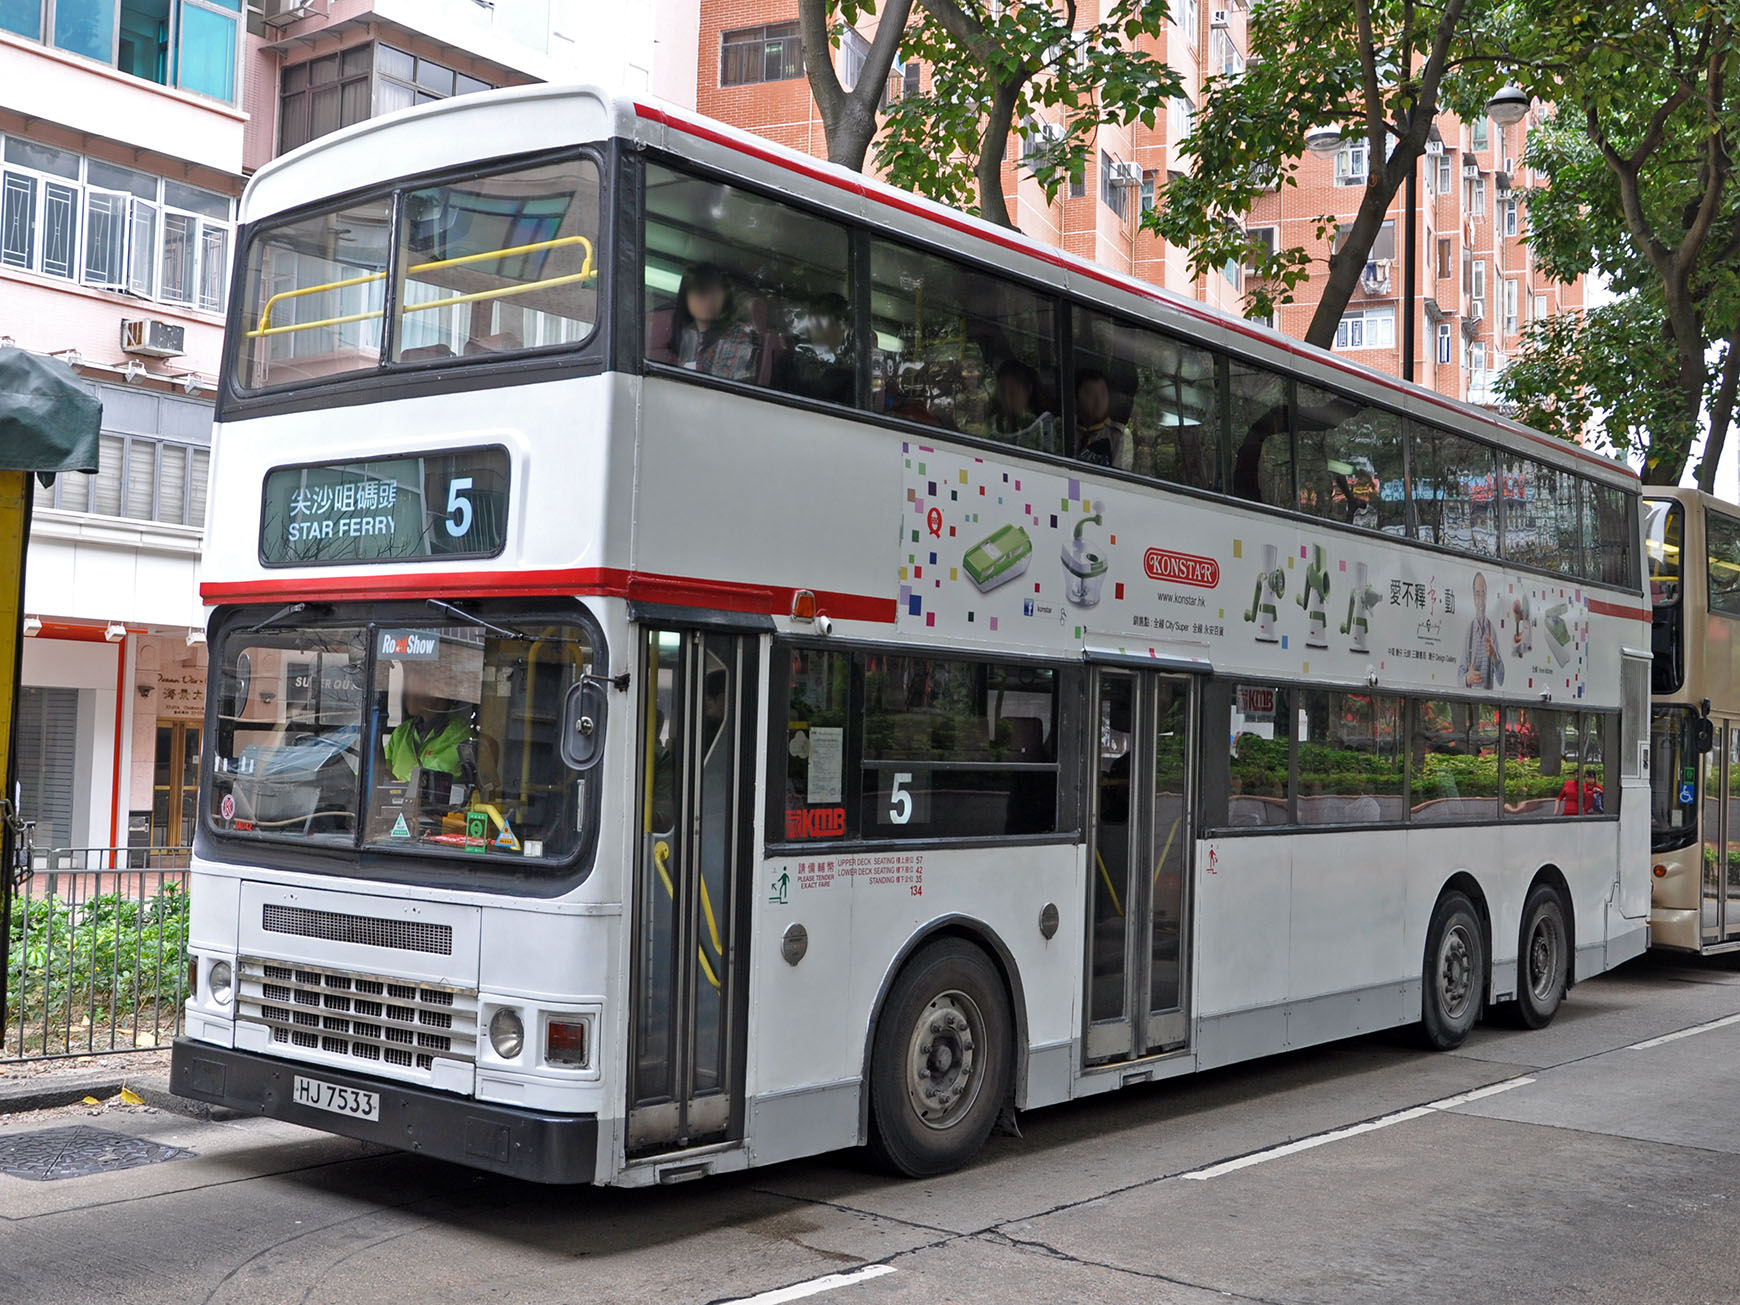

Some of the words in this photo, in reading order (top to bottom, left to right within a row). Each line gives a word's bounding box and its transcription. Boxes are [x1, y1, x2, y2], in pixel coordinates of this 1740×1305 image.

[289, 480, 398, 517] 尖沙咀碼頭
[445, 477, 473, 538] 5
[288, 520, 333, 541] STAR
[338, 515, 395, 537] FERRY
[1148, 554, 1213, 582] KONSTAR
[1157, 592, 1206, 607] www.konstar.hk
[381, 634, 435, 655] RoadShow
[889, 772, 913, 825] 5
[802, 808, 846, 837] KMB
[837, 858, 857, 867] UPPER
[857, 857, 872, 865] DECK
[873, 857, 895, 865] SEATING
[915, 855, 923, 864] 57
[837, 868, 858, 877] LOWER
[858, 868, 873, 876] DECK
[873, 867, 895, 875] SEATING
[915, 866, 923, 874] 42
[815, 873, 835, 881] TENDER
[869, 876, 895, 885] STANDING
[915, 875, 923, 884] 35
[909, 885, 923, 896] 134
[299, 1079, 321, 1104] HJ
[326, 1085, 373, 1116] 7533
